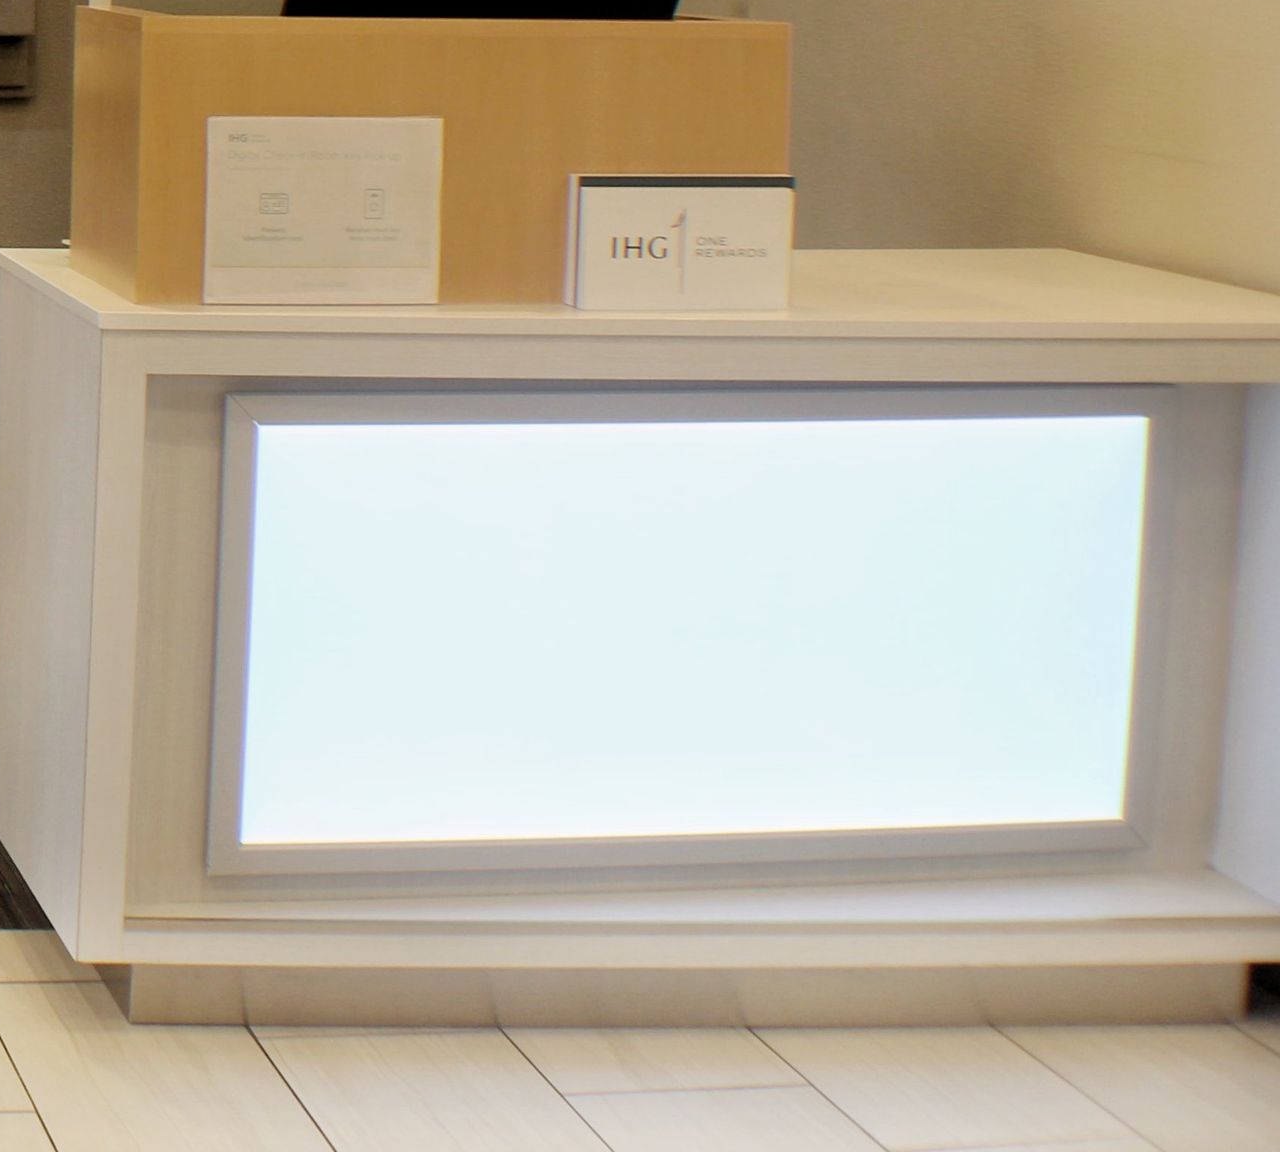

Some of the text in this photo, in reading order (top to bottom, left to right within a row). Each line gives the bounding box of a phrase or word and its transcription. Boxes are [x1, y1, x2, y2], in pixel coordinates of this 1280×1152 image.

[228, 134, 248, 143] IHG
[696, 236, 728, 246] ONE
[611, 236, 668, 259] IHG
[696, 248, 768, 258] REWARDS
